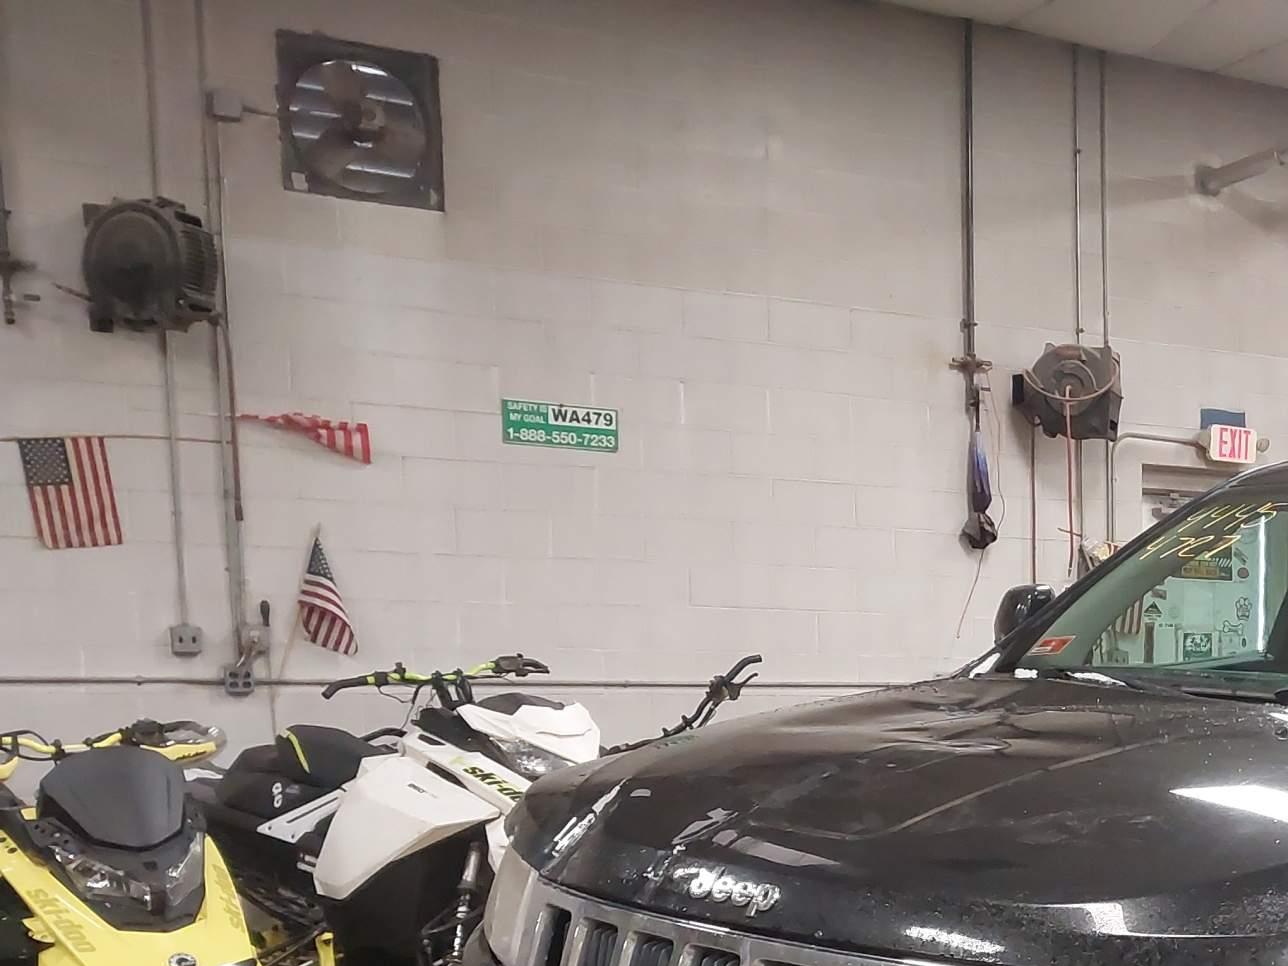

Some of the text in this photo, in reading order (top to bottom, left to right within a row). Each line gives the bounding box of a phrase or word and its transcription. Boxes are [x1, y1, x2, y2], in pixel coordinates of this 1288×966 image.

[507, 401, 538, 411] SAFETY
[551, 407, 613, 426] WA479
[523, 414, 547, 424] GOAL
[507, 427, 615, 447] 1-888-550-7233
[1218, 427, 1251, 460] EXIT
[1177, 502, 1288, 533] 4445
[1139, 535, 1242, 560] 4727
[673, 866, 782, 917] Jeep
[25, 888, 97, 953] ski-doo
